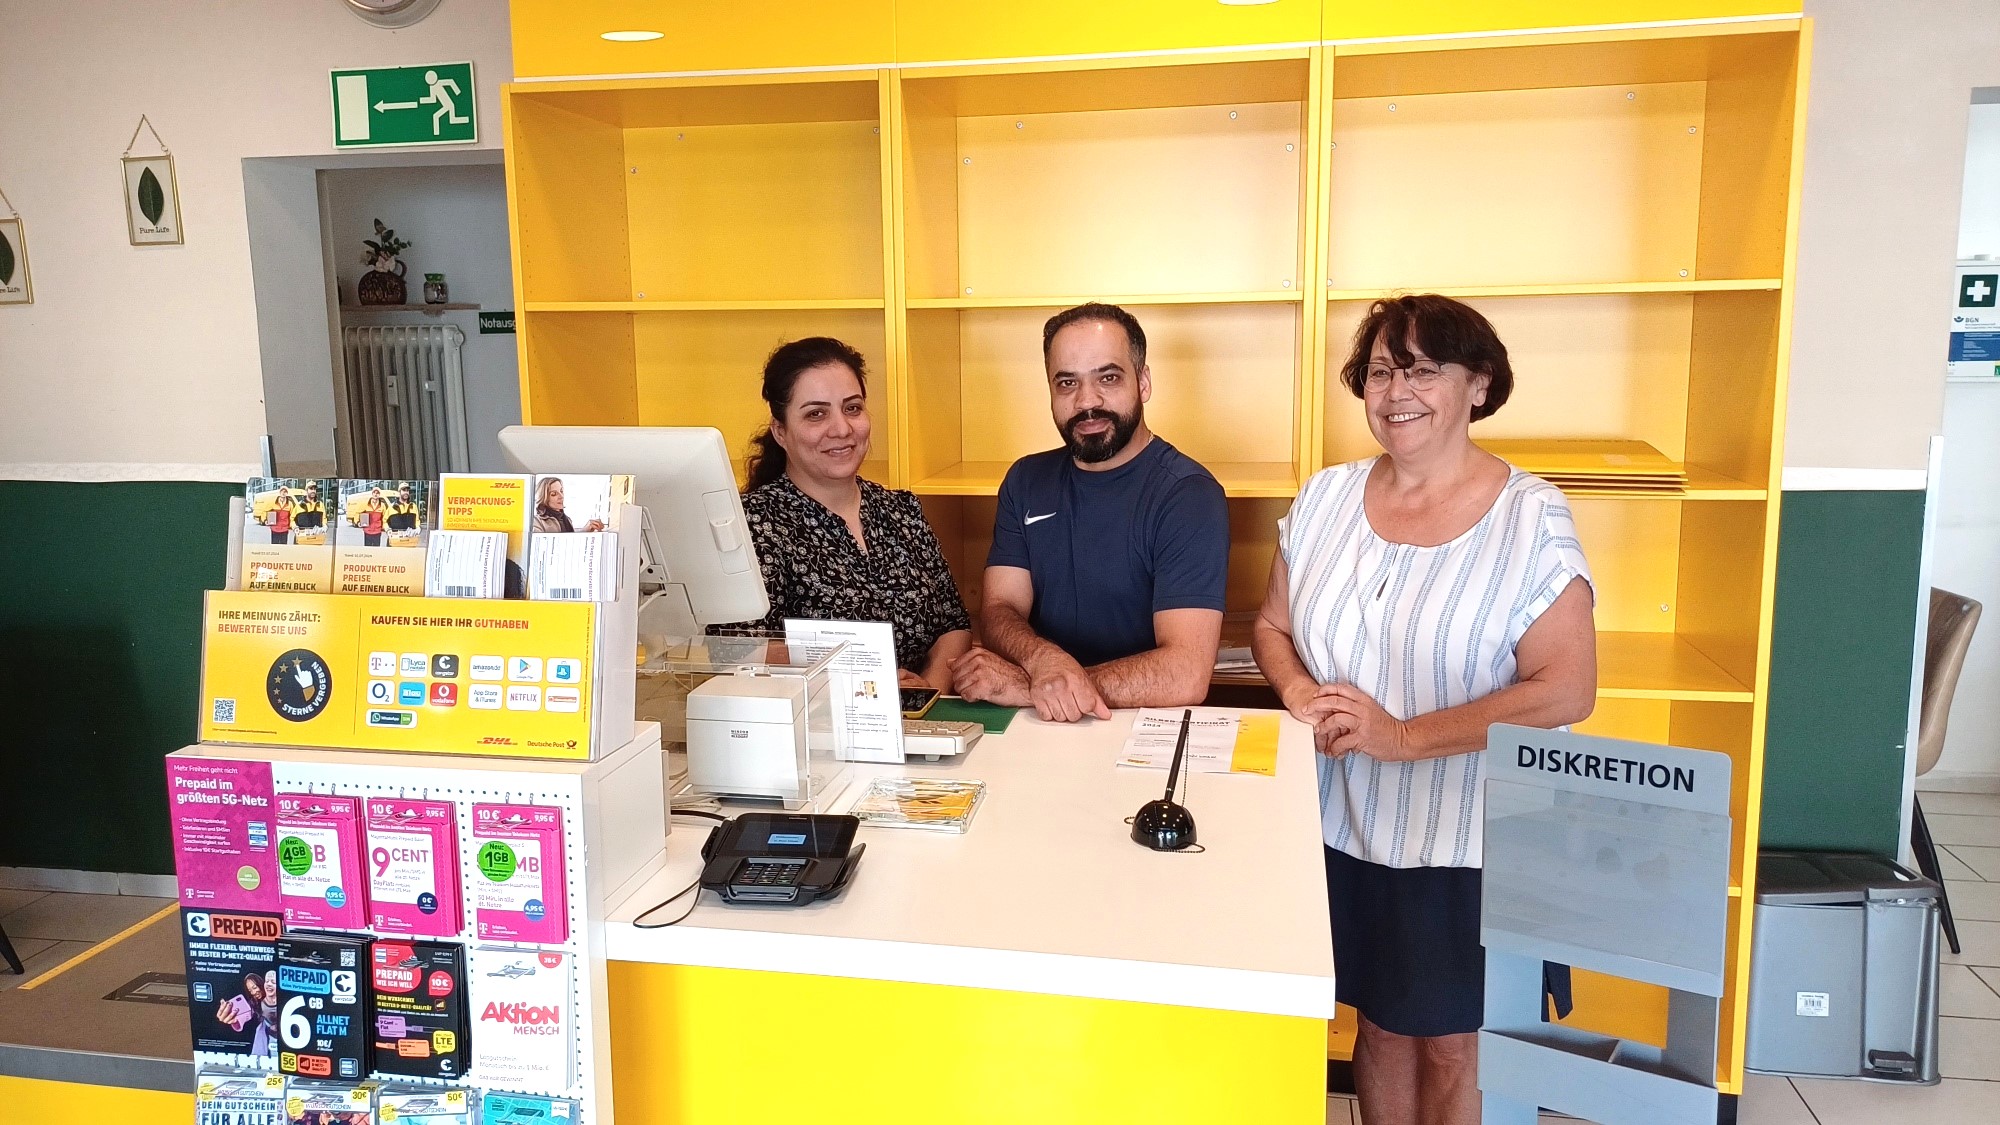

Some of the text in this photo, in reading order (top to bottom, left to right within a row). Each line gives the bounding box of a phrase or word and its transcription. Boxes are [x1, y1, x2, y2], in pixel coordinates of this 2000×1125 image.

[140, 227, 154, 235] Pure
[448, 497, 515, 505] VERPACKUNGS-
[251, 562, 312, 571] PRODUKTE UND
[344, 565, 387, 573] PRODUKTE
[343, 574, 371, 582] PREISE
[268, 582, 291, 590] EINEN
[294, 583, 316, 591] BLICK
[342, 584, 358, 592] AUF
[219, 611, 321, 622] IHRE MEINUNG ZÄHLT:
[372, 616, 529, 629] KAUFEN SIE HIER IHR GUTHABEN
[218, 624, 307, 635] BEWERTEN SIE UNS
[282, 662, 326, 715] STERNE VERGEBEN
[510, 693, 537, 702] NETFLIX
[479, 737, 515, 745] DHL
[1518, 745, 1694, 792] DISKRETION
[175, 777, 233, 791] Prepaid im
[177, 793, 268, 807] größten 5G-Netz
[279, 800, 291, 809] 10
[372, 804, 394, 814] 10 €
[426, 810, 438, 818] 9,95
[478, 810, 500, 820] 10 €
[372, 847, 428, 877] 9 CENT
[485, 852, 509, 868] 1GB
[213, 918, 277, 937] PREPAID
[210, 943, 237, 951] FLEXIBEL
[222, 952, 273, 962] D-NETZ-QUALITÄT
[281, 968, 327, 984] PREPAID
[376, 969, 412, 981] PREPAID
[432, 979, 448, 987] 10 €
[280, 995, 323, 1049] 6 GB
[317, 1014, 350, 1026] ALLNET
[316, 1025, 347, 1036] FLAT M
[514, 1026, 559, 1035] MENSCH
[436, 1037, 452, 1046] LTE
[283, 1057, 295, 1066] 5G
[267, 1077, 283, 1085] 25€
[353, 1091, 367, 1100] 30€
[447, 1093, 462, 1101] 50€
[202, 1101, 275, 1110] DEIN GUTSCHEIN
[202, 1110, 274, 1125] FÜR ALLE
